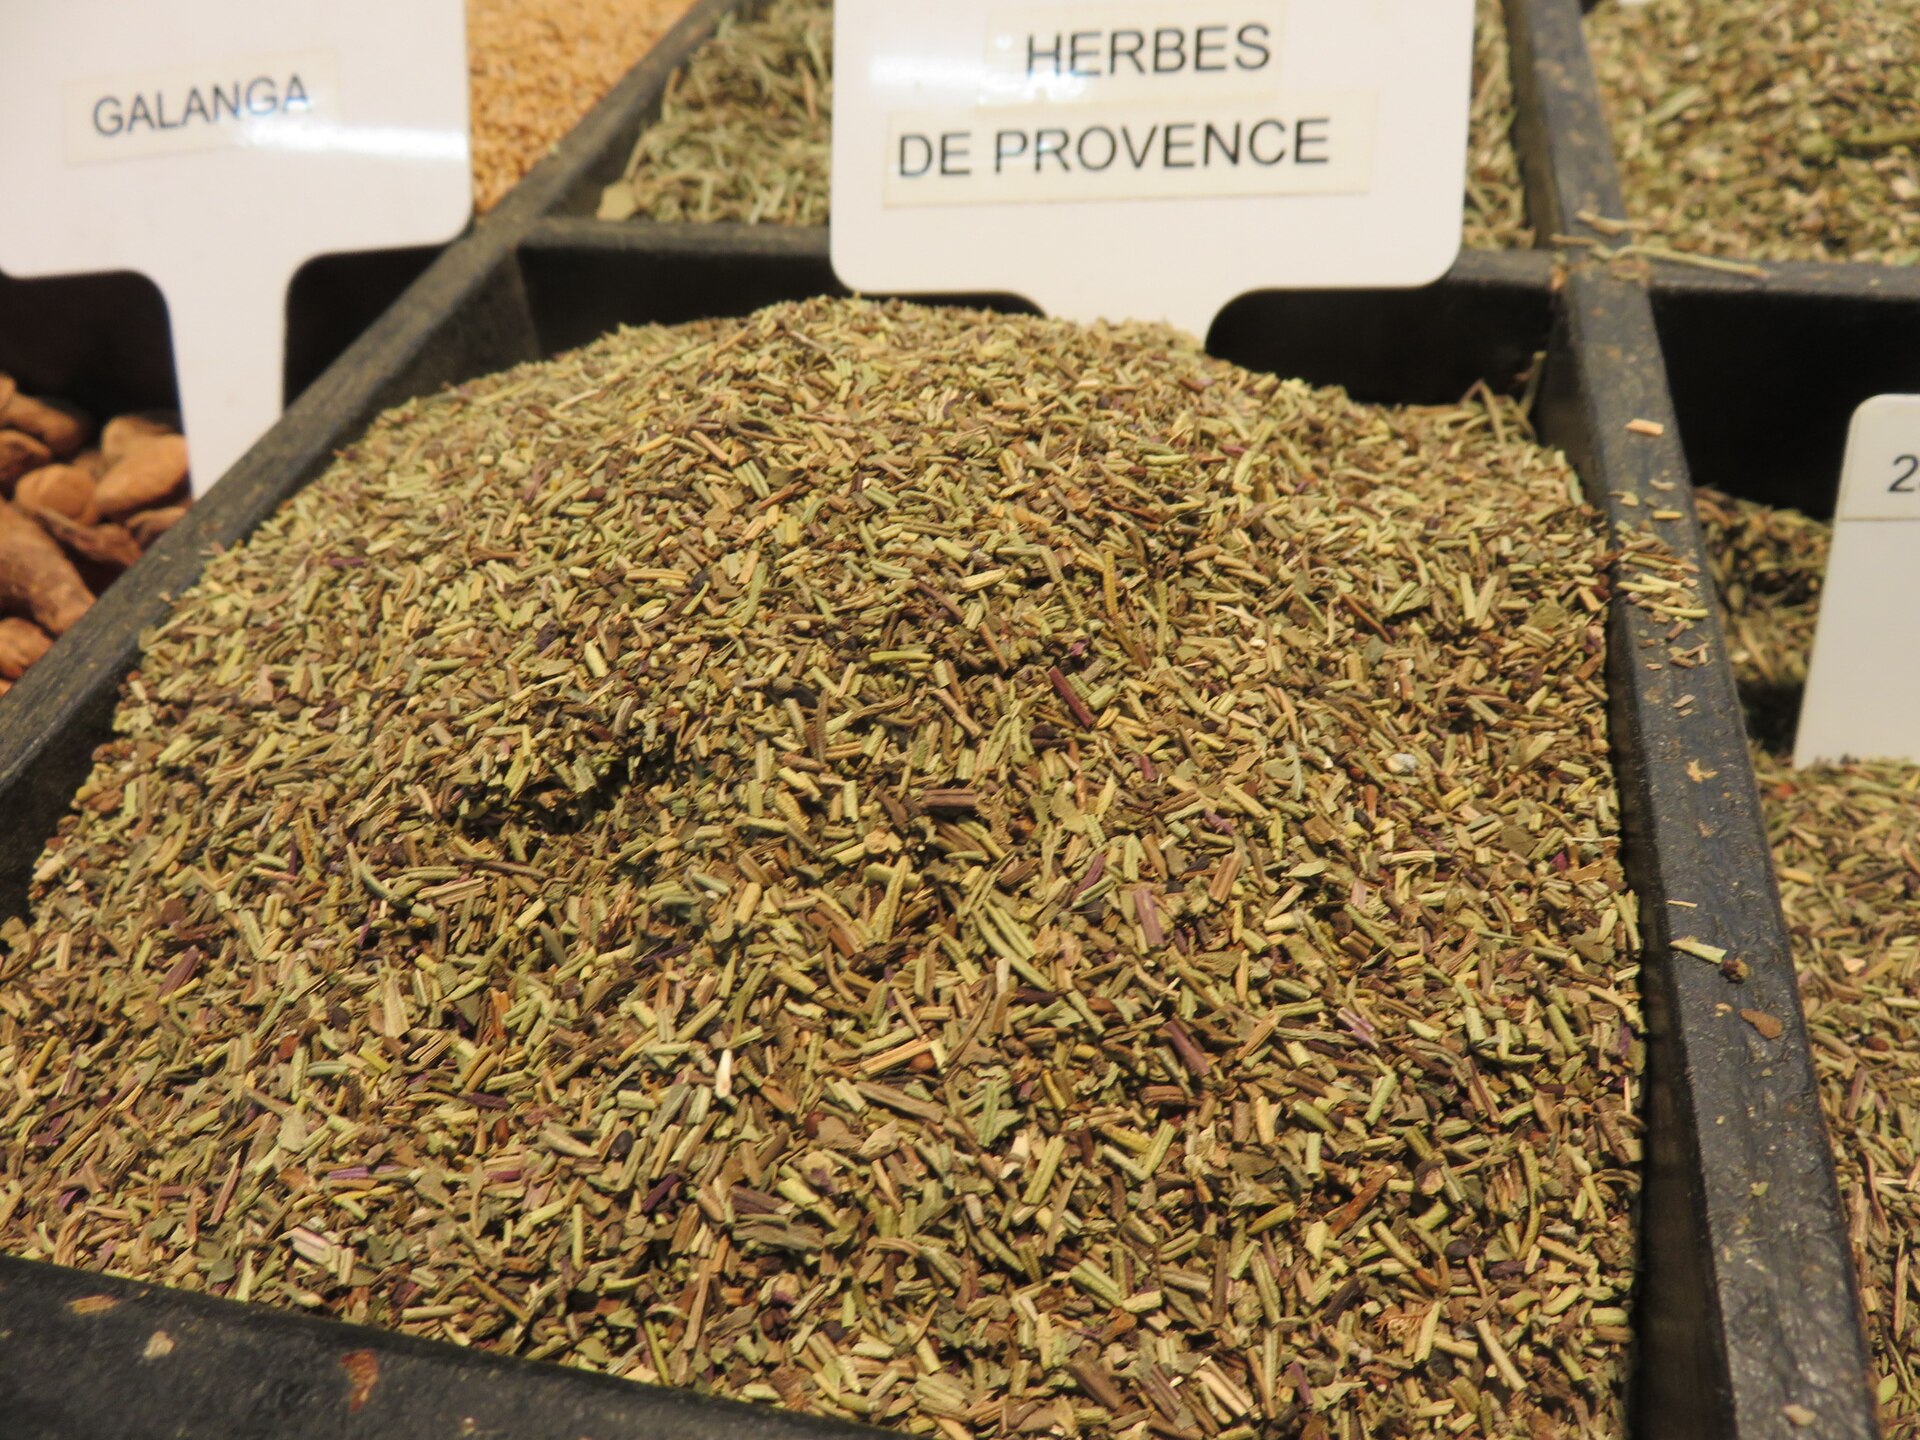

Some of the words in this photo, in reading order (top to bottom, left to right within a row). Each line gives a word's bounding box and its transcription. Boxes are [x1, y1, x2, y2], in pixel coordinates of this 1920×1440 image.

[1026, 23, 1271, 78] HERBES
[92, 73, 312, 137] GALANGA
[898, 131, 971, 178] DE
[995, 117, 1331, 176] PROVENCE
[1888, 453, 1920, 493] 2
